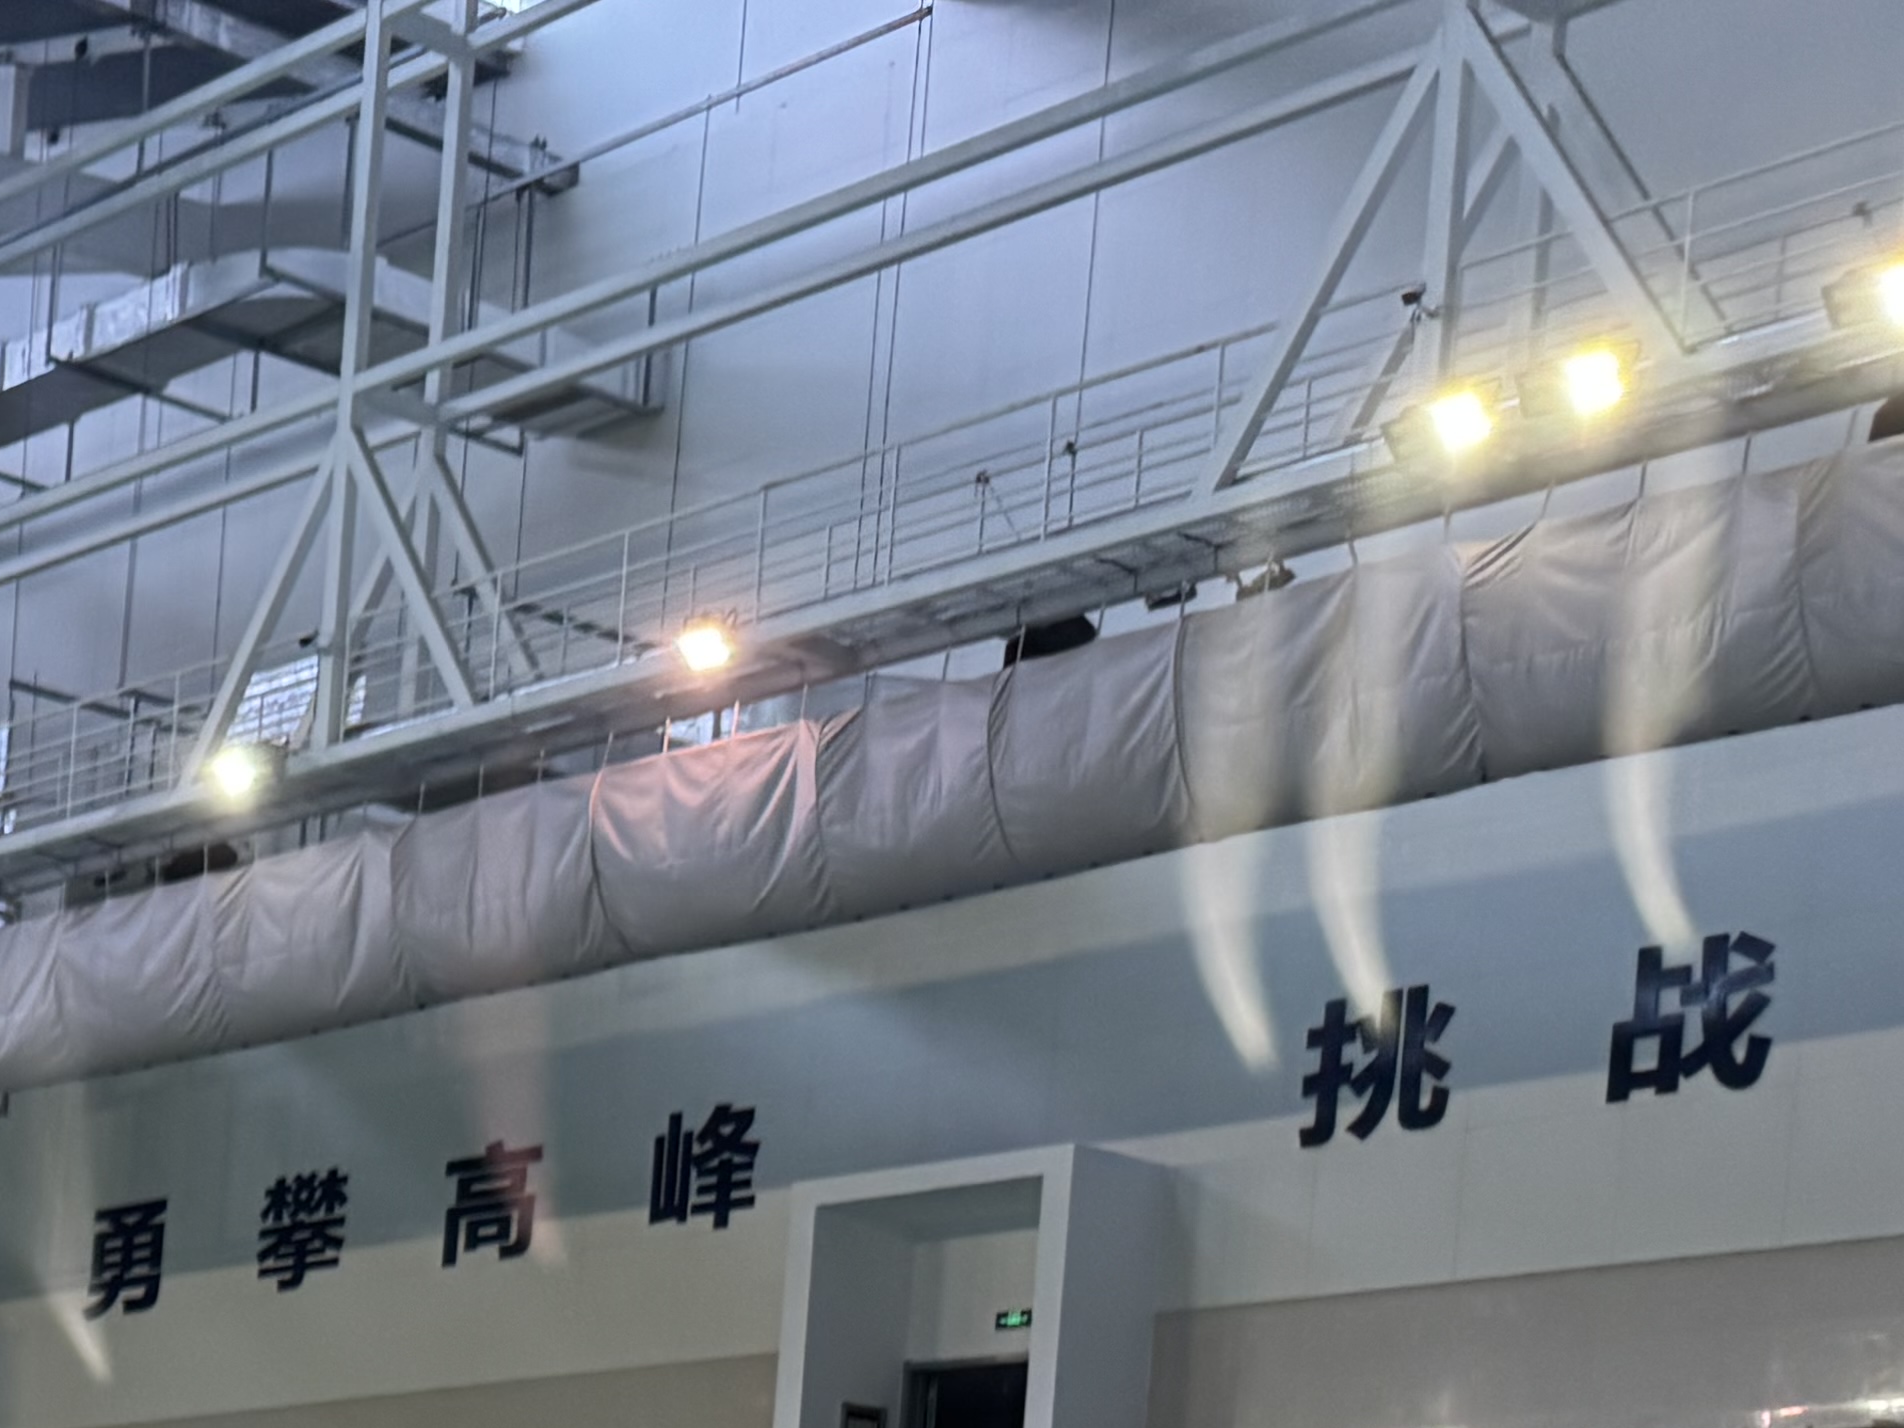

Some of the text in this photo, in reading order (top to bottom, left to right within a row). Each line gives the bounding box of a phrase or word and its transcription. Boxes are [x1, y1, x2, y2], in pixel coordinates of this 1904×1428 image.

[84, 1102, 761, 1320] 勇攀高峰
[1299, 931, 1776, 1148] 挑战
